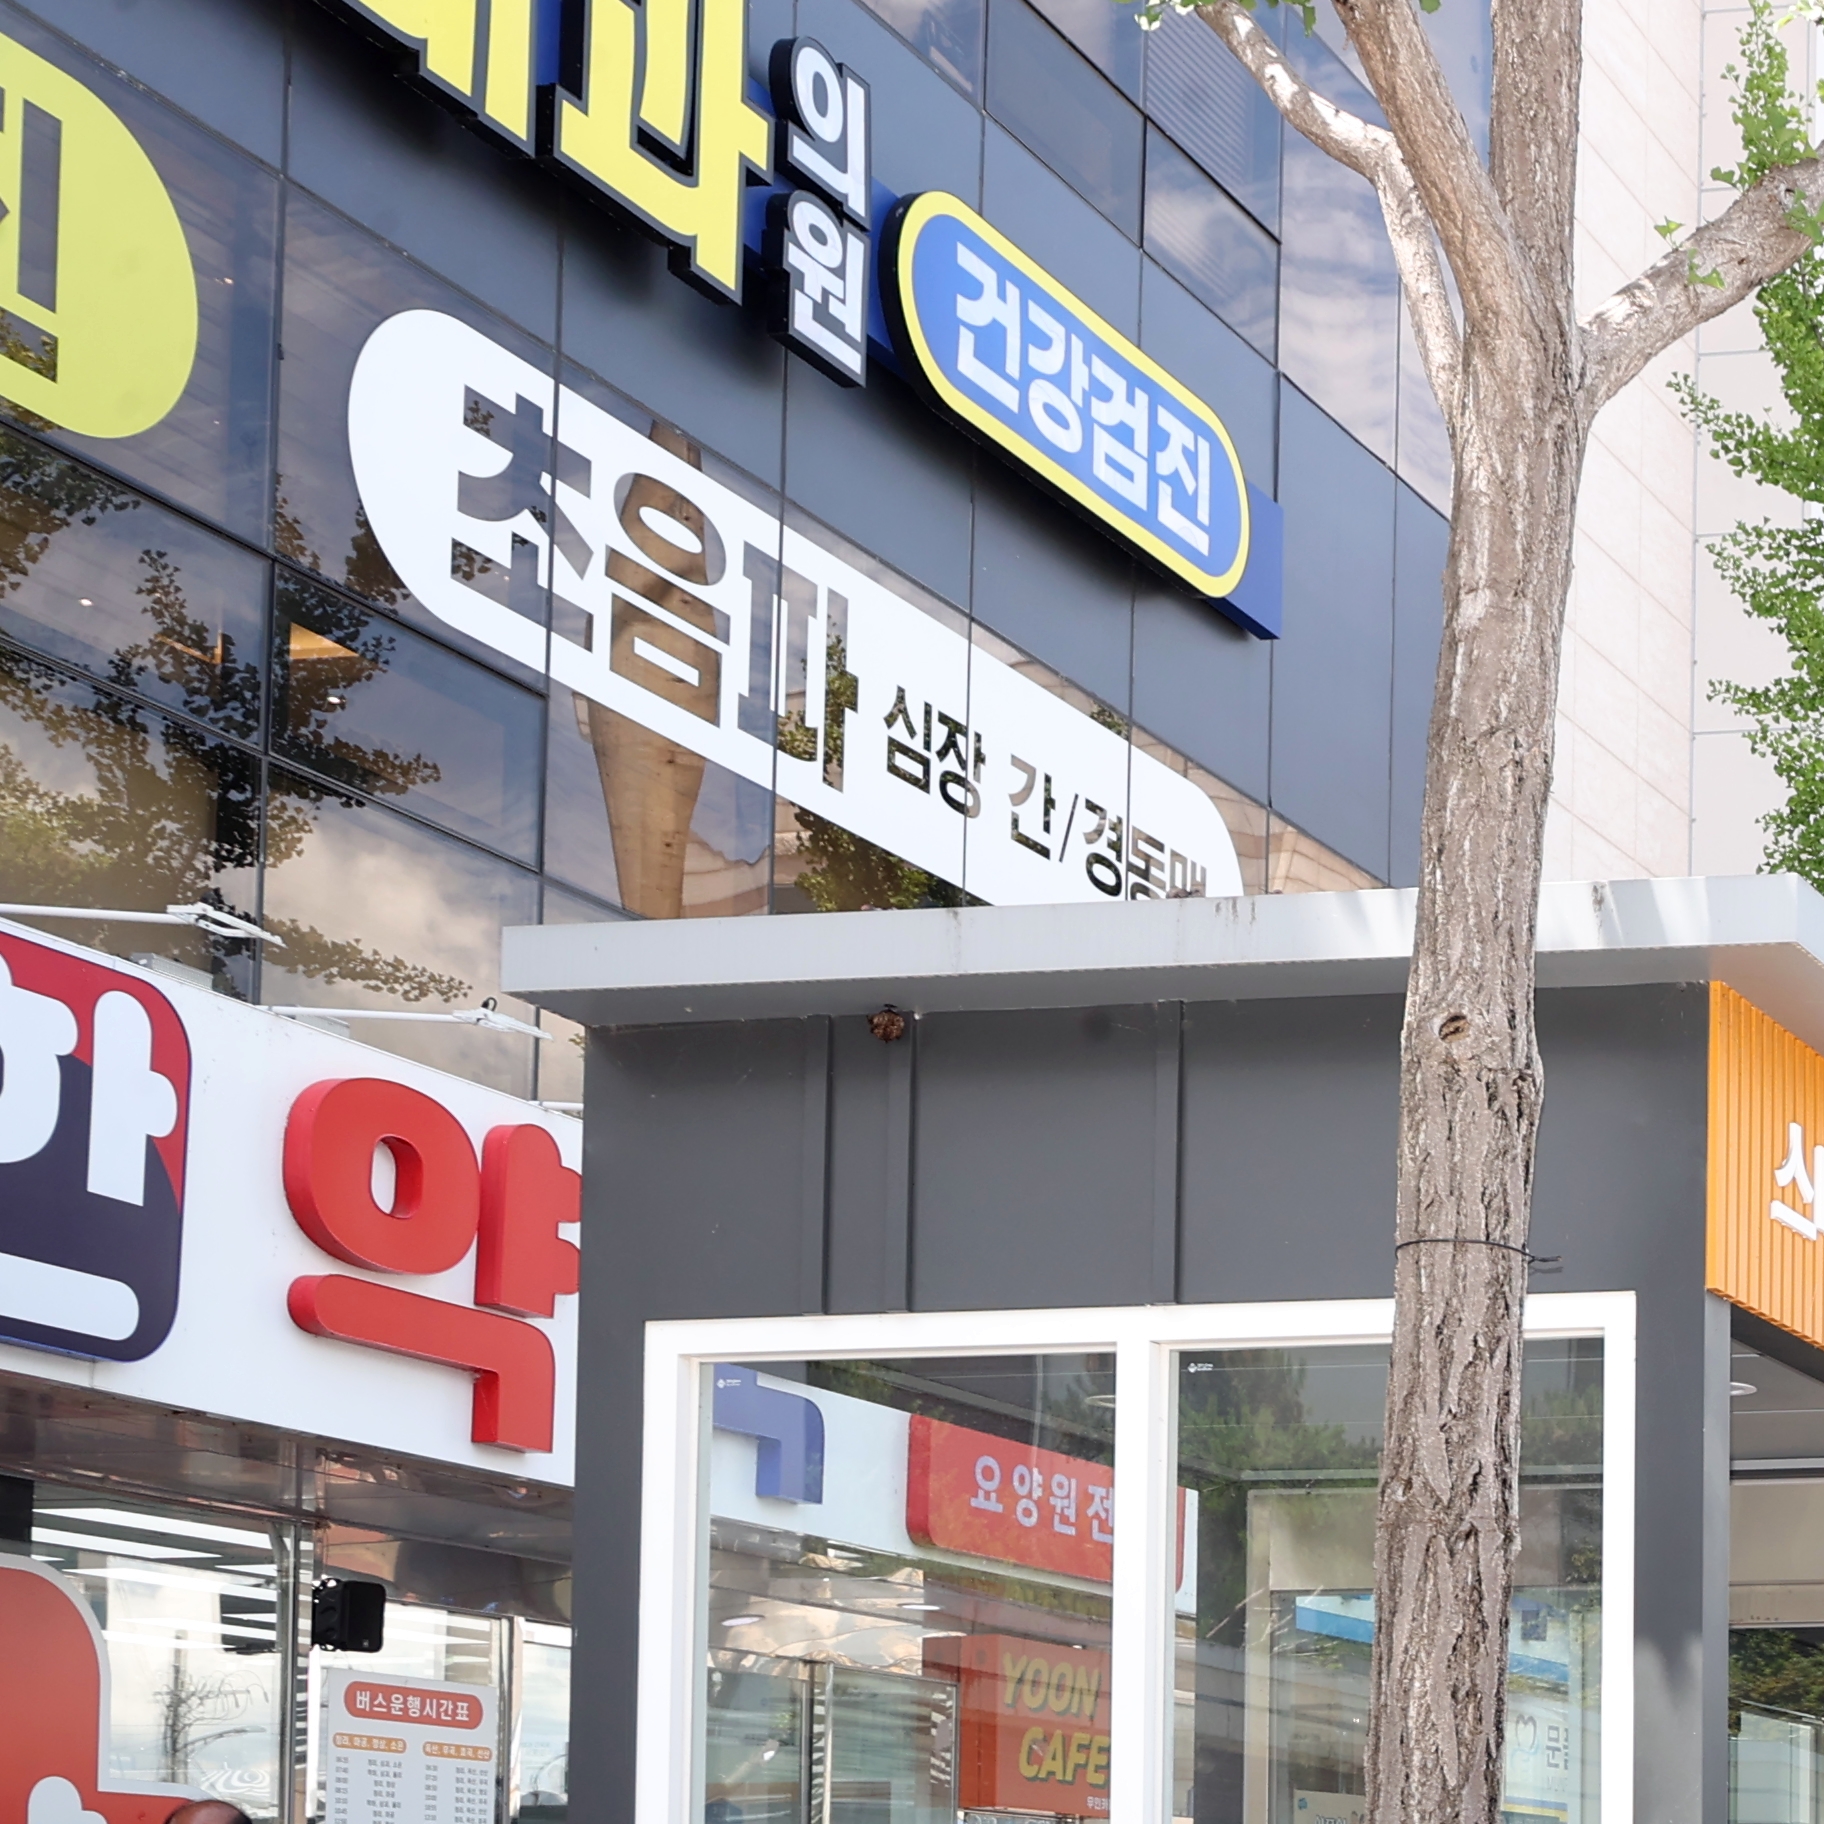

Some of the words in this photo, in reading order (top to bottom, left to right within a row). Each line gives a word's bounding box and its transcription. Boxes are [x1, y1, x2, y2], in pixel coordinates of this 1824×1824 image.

[786, 46, 867, 375] 의원
[954, 241, 1213, 555] 건강검진
[450, 383, 859, 793] 초음파
[883, 684, 986, 819] 심장
[283, 1077, 582, 1453] 약
[356, 1690, 470, 1722] 버스운행시간표
[1002, 1651, 1101, 1719] YOON
[1019, 1725, 1111, 1791] CAFE
